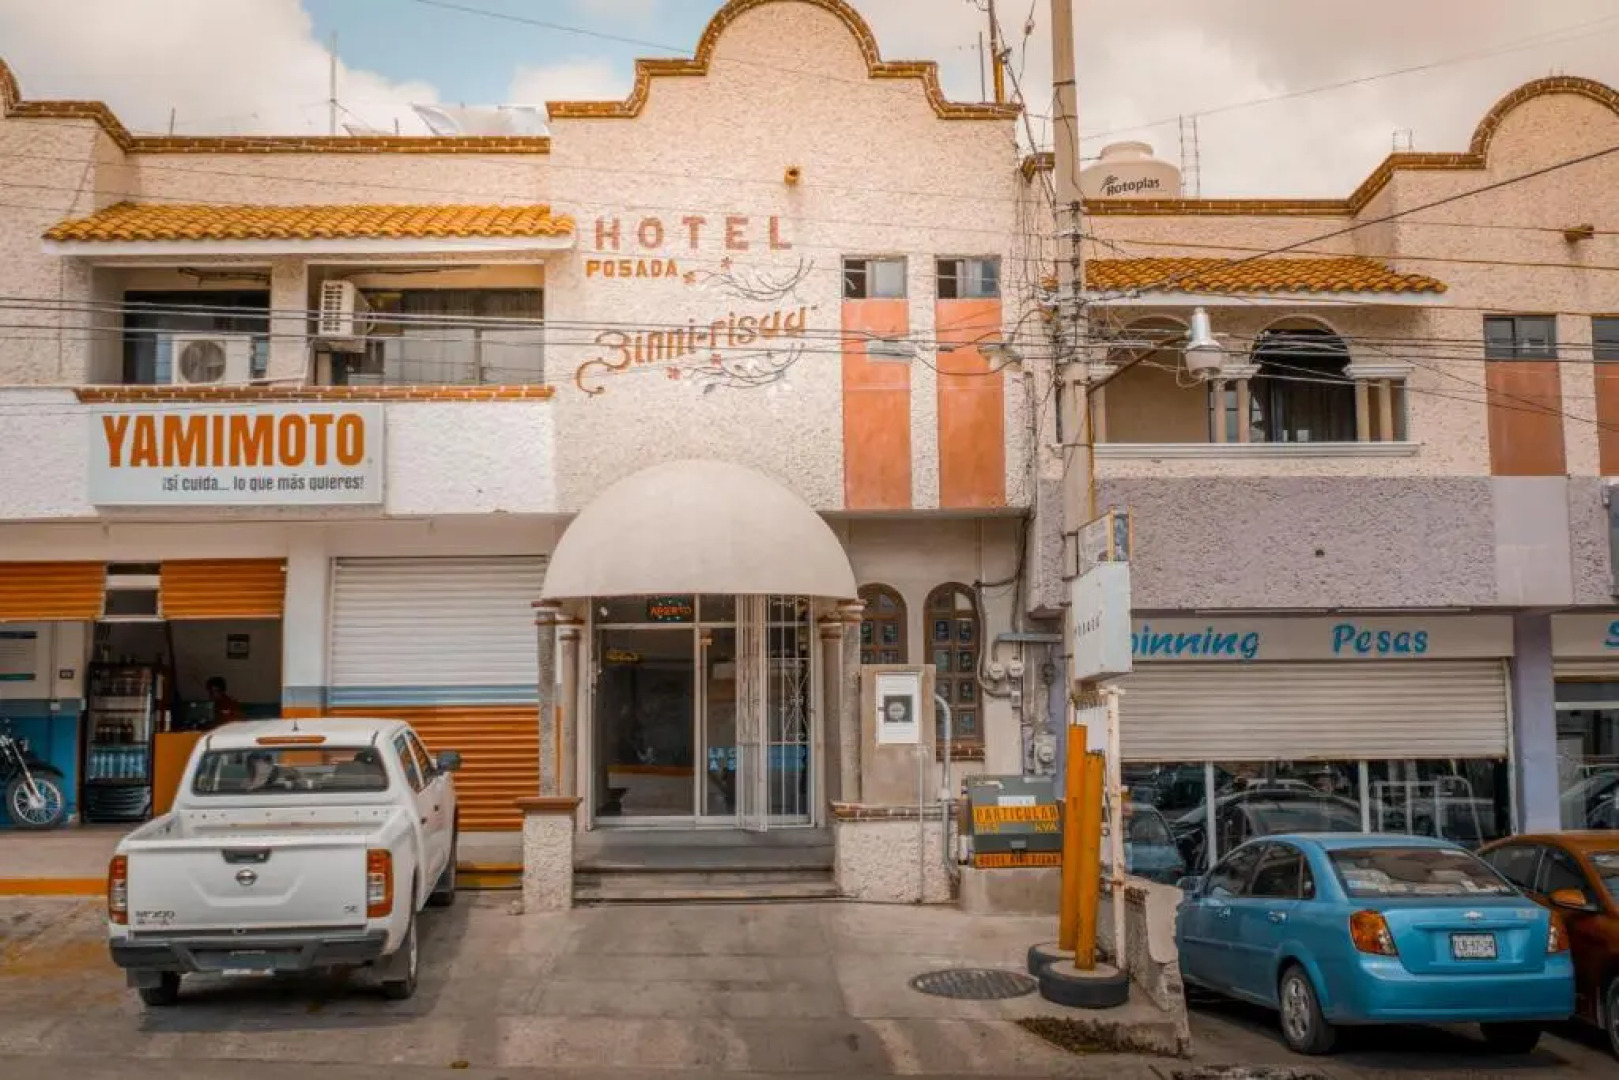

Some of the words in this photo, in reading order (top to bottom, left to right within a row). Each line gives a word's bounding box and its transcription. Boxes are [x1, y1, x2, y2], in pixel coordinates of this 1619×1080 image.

[1105, 177, 1160, 196] Rotoplas
[595, 215, 792, 251] HOTEL
[586, 258, 678, 278] POSADA
[102, 413, 365, 468] YAMIMOTO
[233, 475, 246, 491] lo
[249, 476, 273, 492] que
[277, 473, 305, 491] más
[1332, 623, 1428, 653] Pesas
